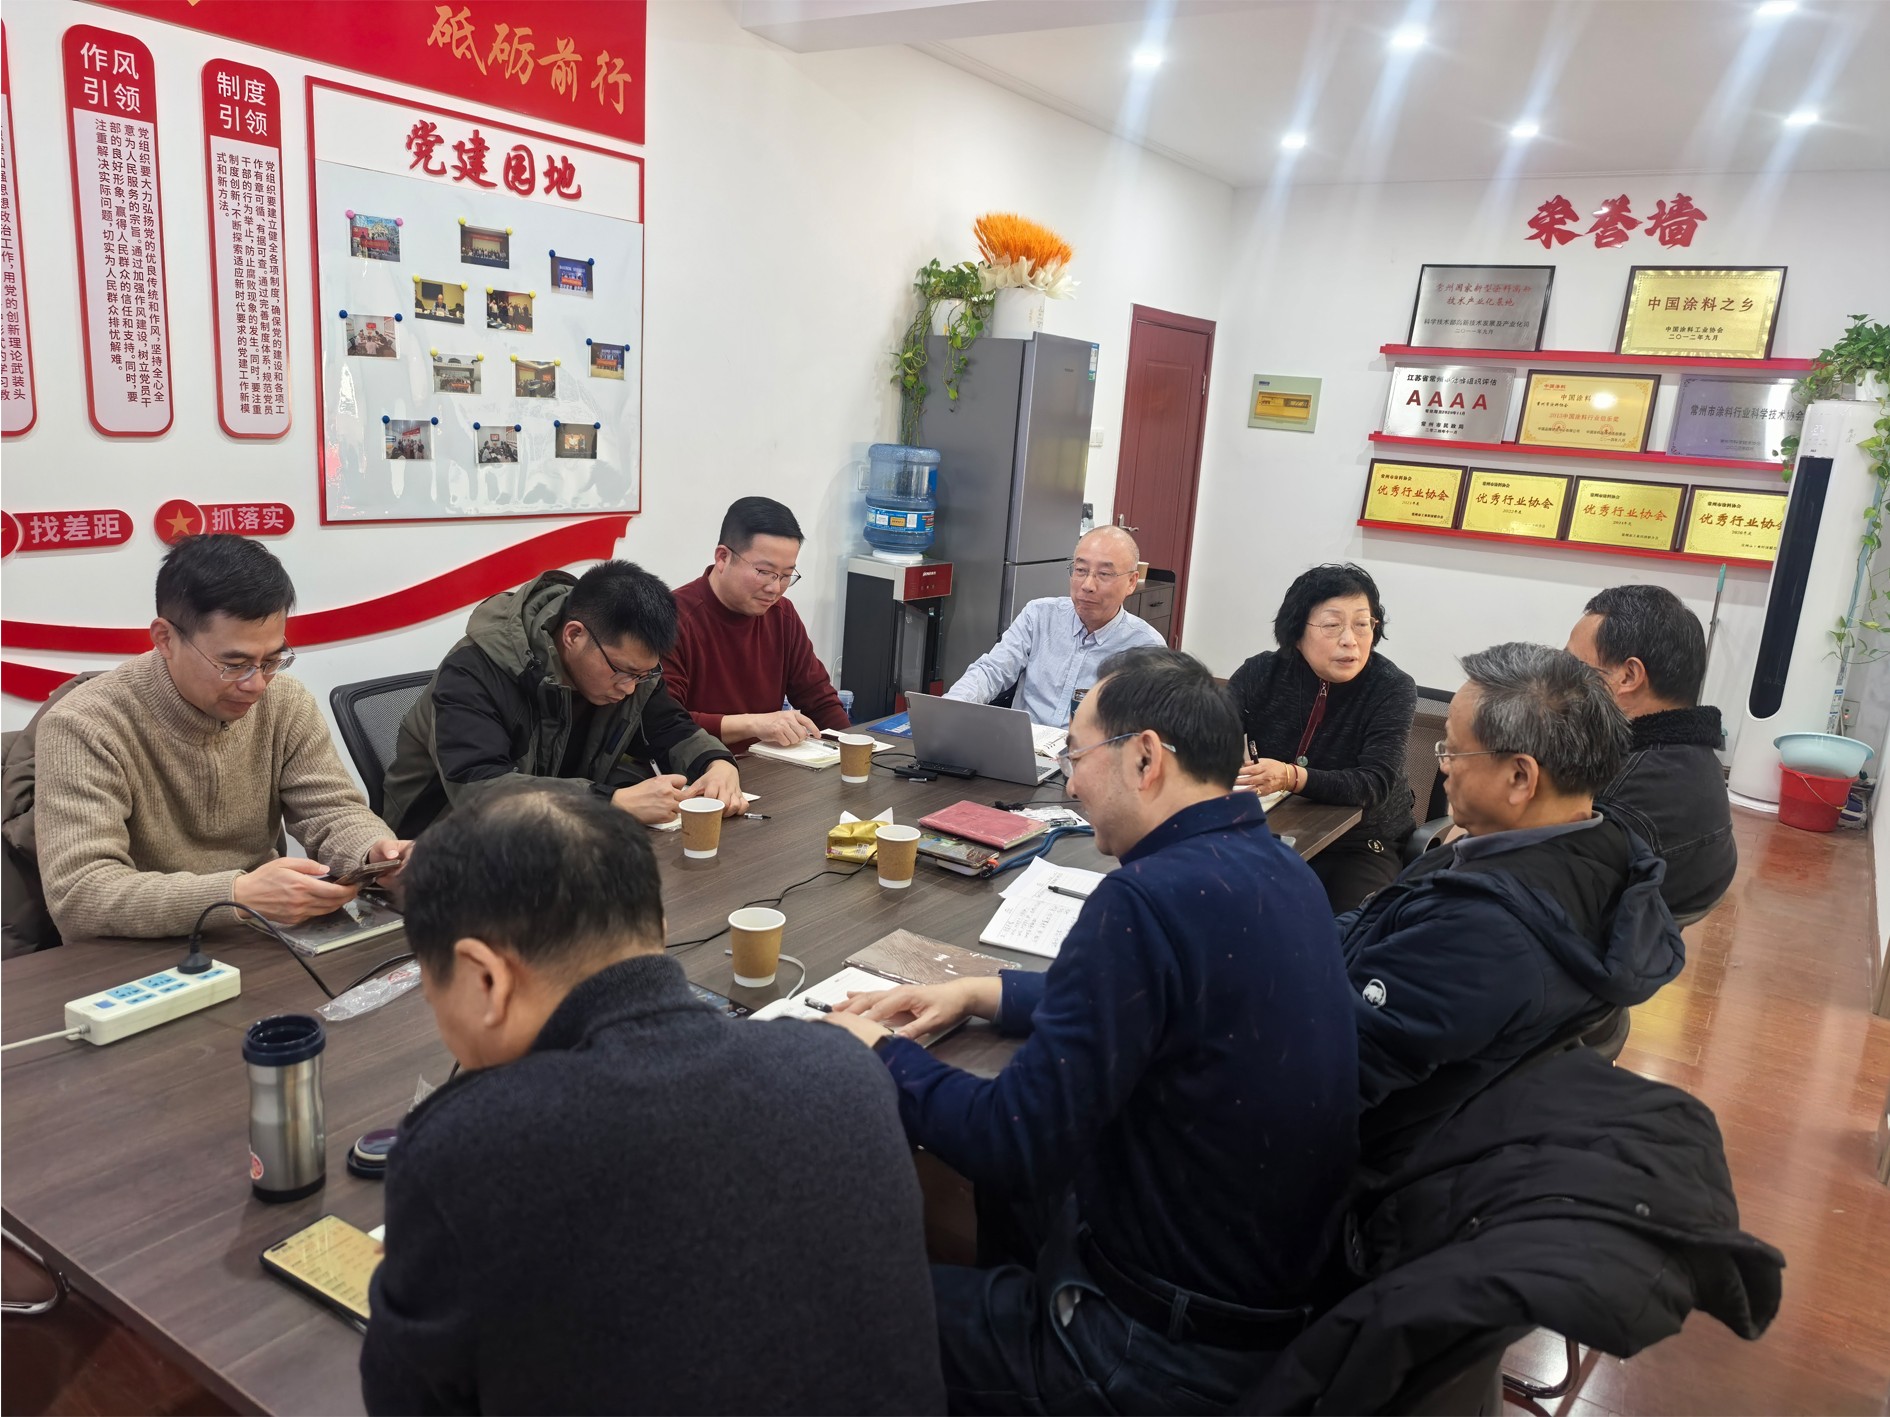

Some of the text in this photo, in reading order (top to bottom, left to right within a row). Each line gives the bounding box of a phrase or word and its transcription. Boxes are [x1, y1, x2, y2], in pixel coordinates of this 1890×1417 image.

[80, 42, 139, 80] 作风
[427, 5, 632, 115] 砥砺前行
[84, 76, 141, 113] 引领
[217, 72, 266, 106] 制度
[219, 103, 267, 136] 引领
[405, 119, 582, 200] 党建园地
[216, 152, 229, 217] 式和新方法。
[1523, 192, 1708, 250] 荣誉墙
[1648, 296, 1754, 313] 中国涂料之乡
[1665, 325, 1724, 334] 中国涂料工业协会
[1690, 404, 1805, 421] 常州市涂料行业科学技术协会
[1377, 485, 1450, 502] 优秀行业协会
[1475, 492, 1554, 510] 优秀行业协会
[212, 507, 284, 530] 抓落实
[1583, 503, 1668, 522] 优秀行业协会
[30, 514, 122, 543] 找差距
